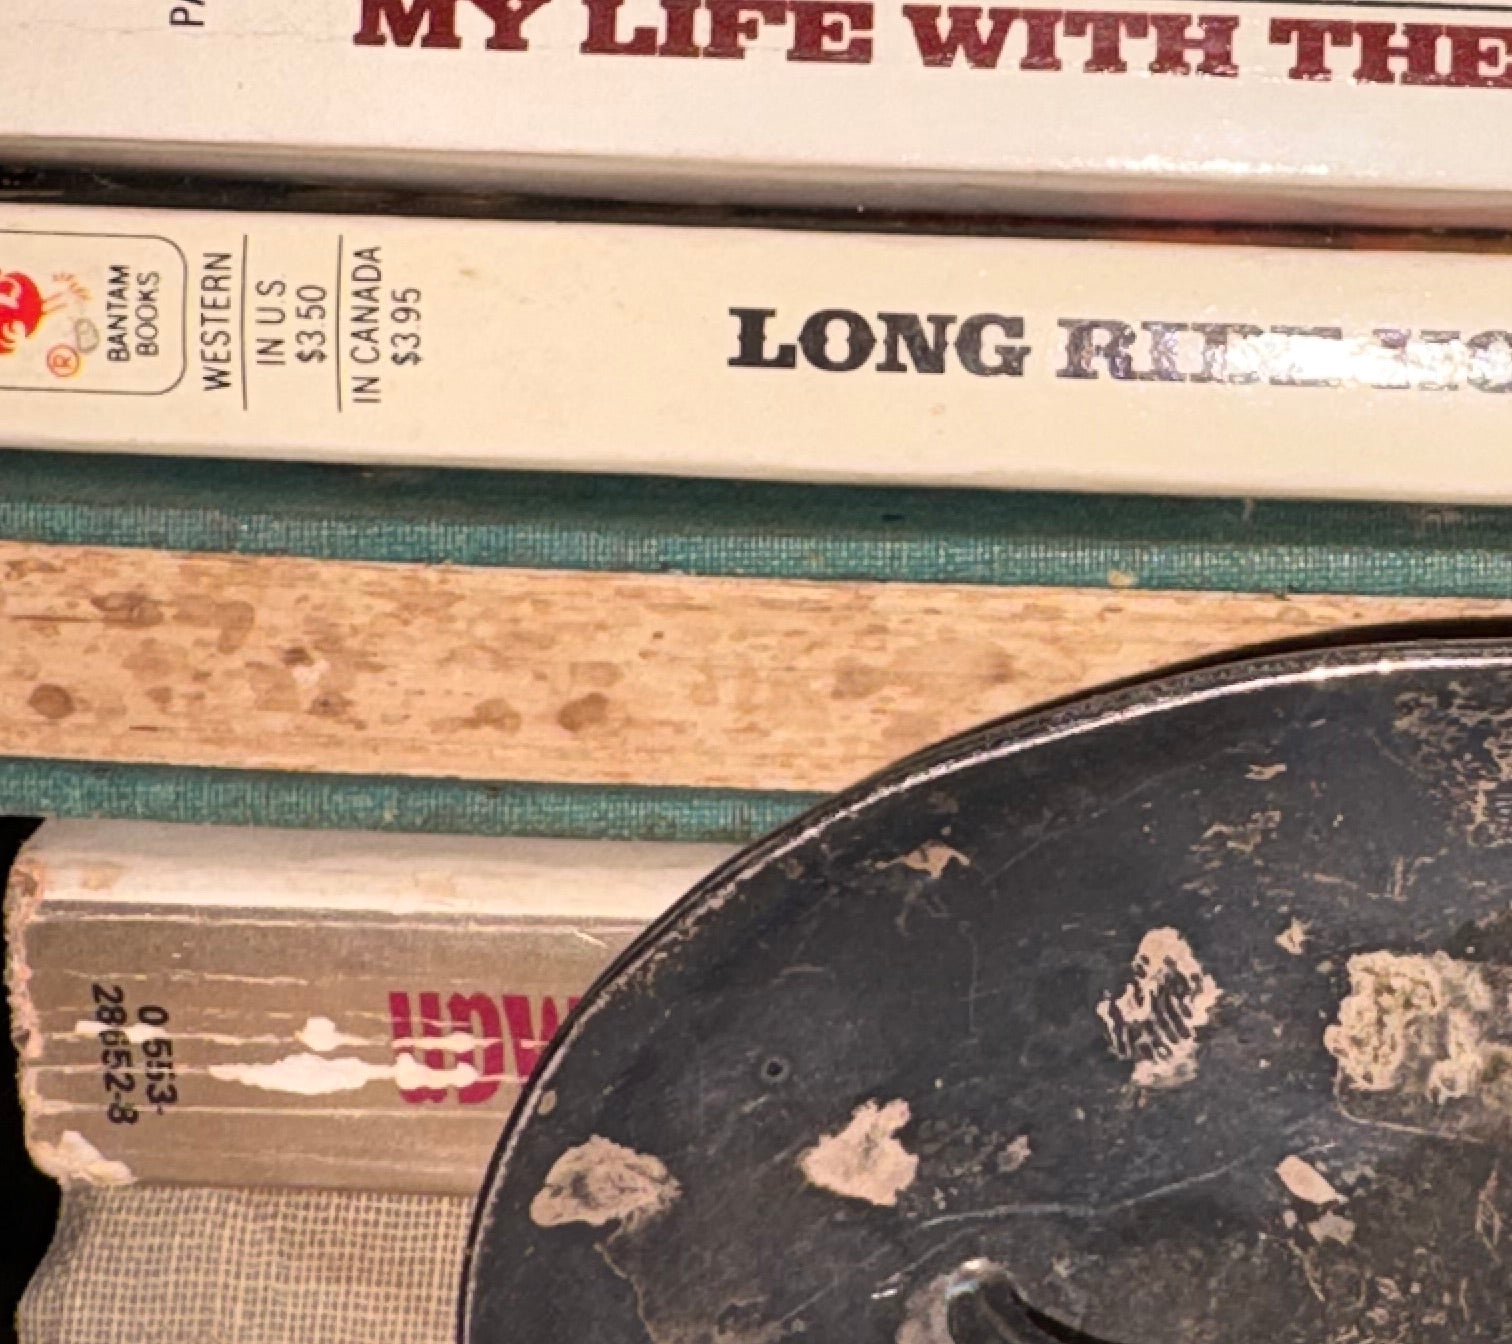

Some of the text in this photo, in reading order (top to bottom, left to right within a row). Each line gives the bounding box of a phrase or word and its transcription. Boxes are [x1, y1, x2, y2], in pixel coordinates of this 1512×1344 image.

[902, 4, 1240, 78] WITH
[106, 264, 130, 362] BANTAM
[134, 270, 160, 357] BOOKS
[200, 251, 233, 391] WESTERN
[256, 340, 287, 366] IN
[294, 283, 328, 363] $3.50
[350, 246, 382, 404] IN CANADA
[390, 286, 423, 366] $3.95
[728, 306, 1032, 379] LONG
[1056, 317, 1346, 388] RID
[92, 983, 140, 1125] 28652-8
